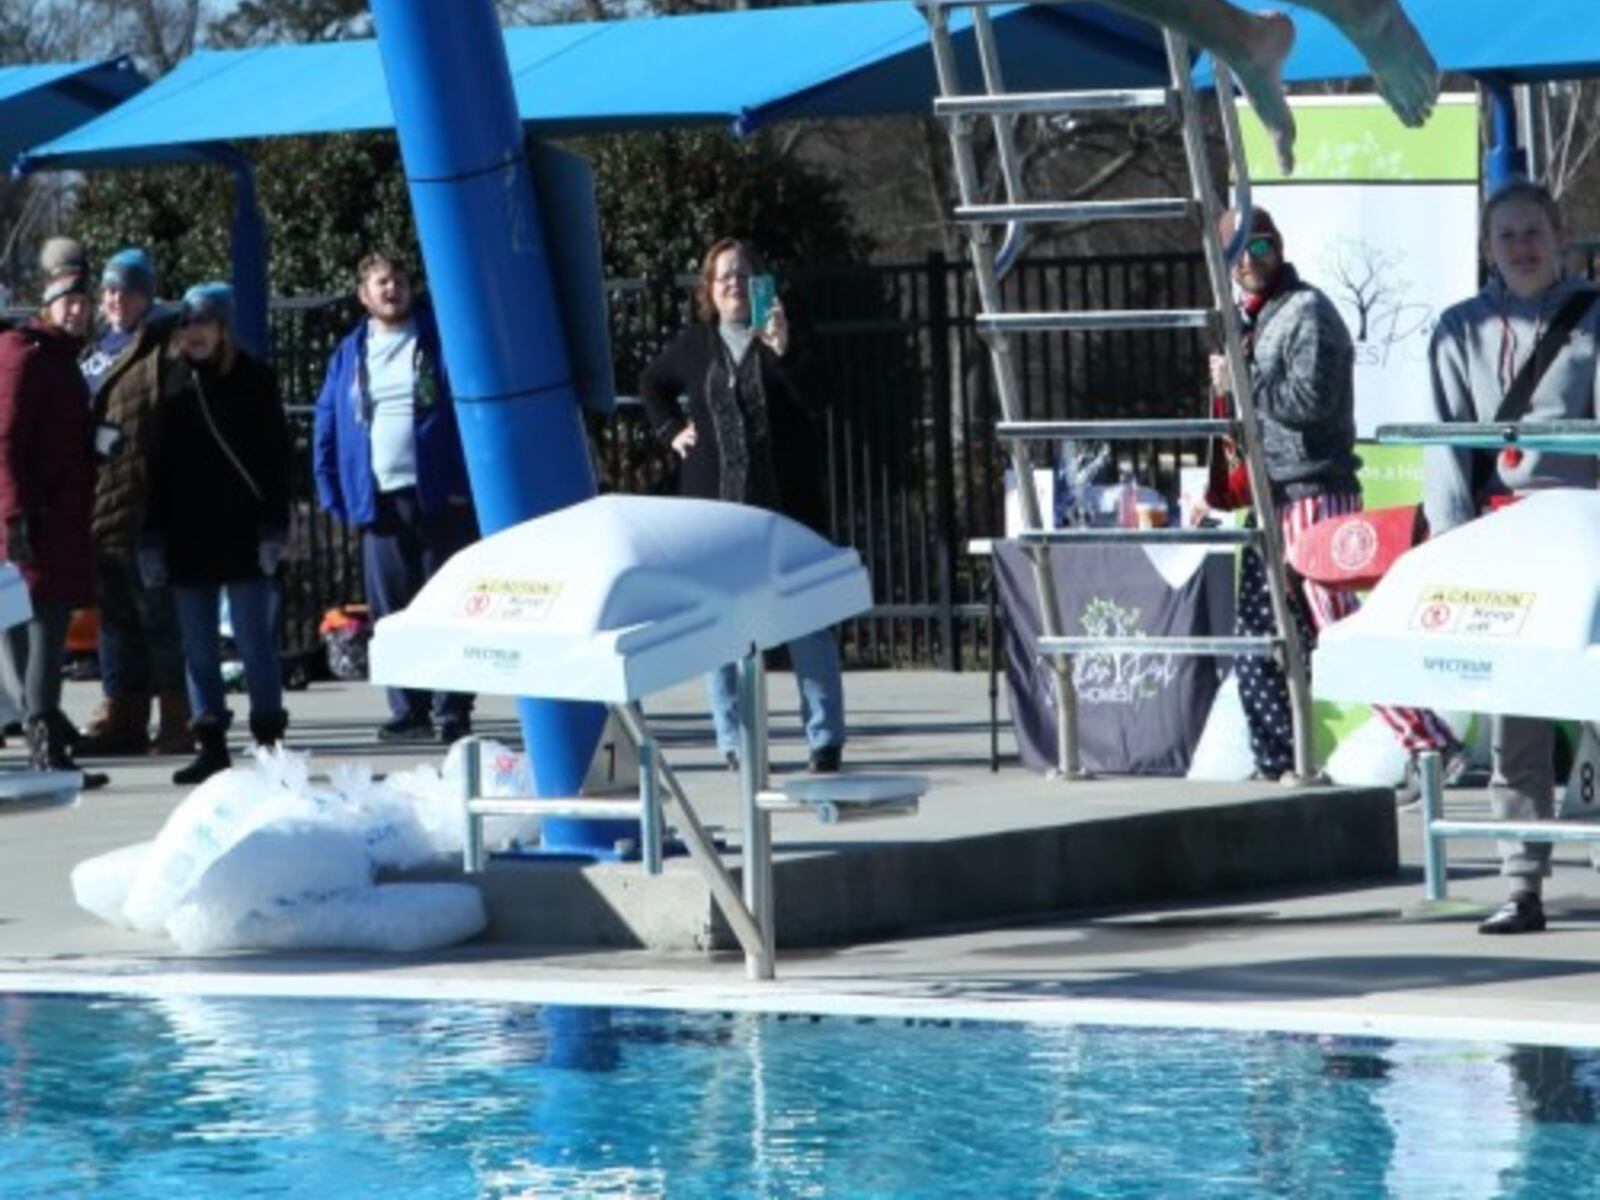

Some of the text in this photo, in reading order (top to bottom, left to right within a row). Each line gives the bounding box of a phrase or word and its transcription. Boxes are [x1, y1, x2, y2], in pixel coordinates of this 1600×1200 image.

[1446, 590, 1523, 607] CAUTION
[1423, 657, 1492, 673] SPECTRUM
[1580, 761, 1594, 802] 8
